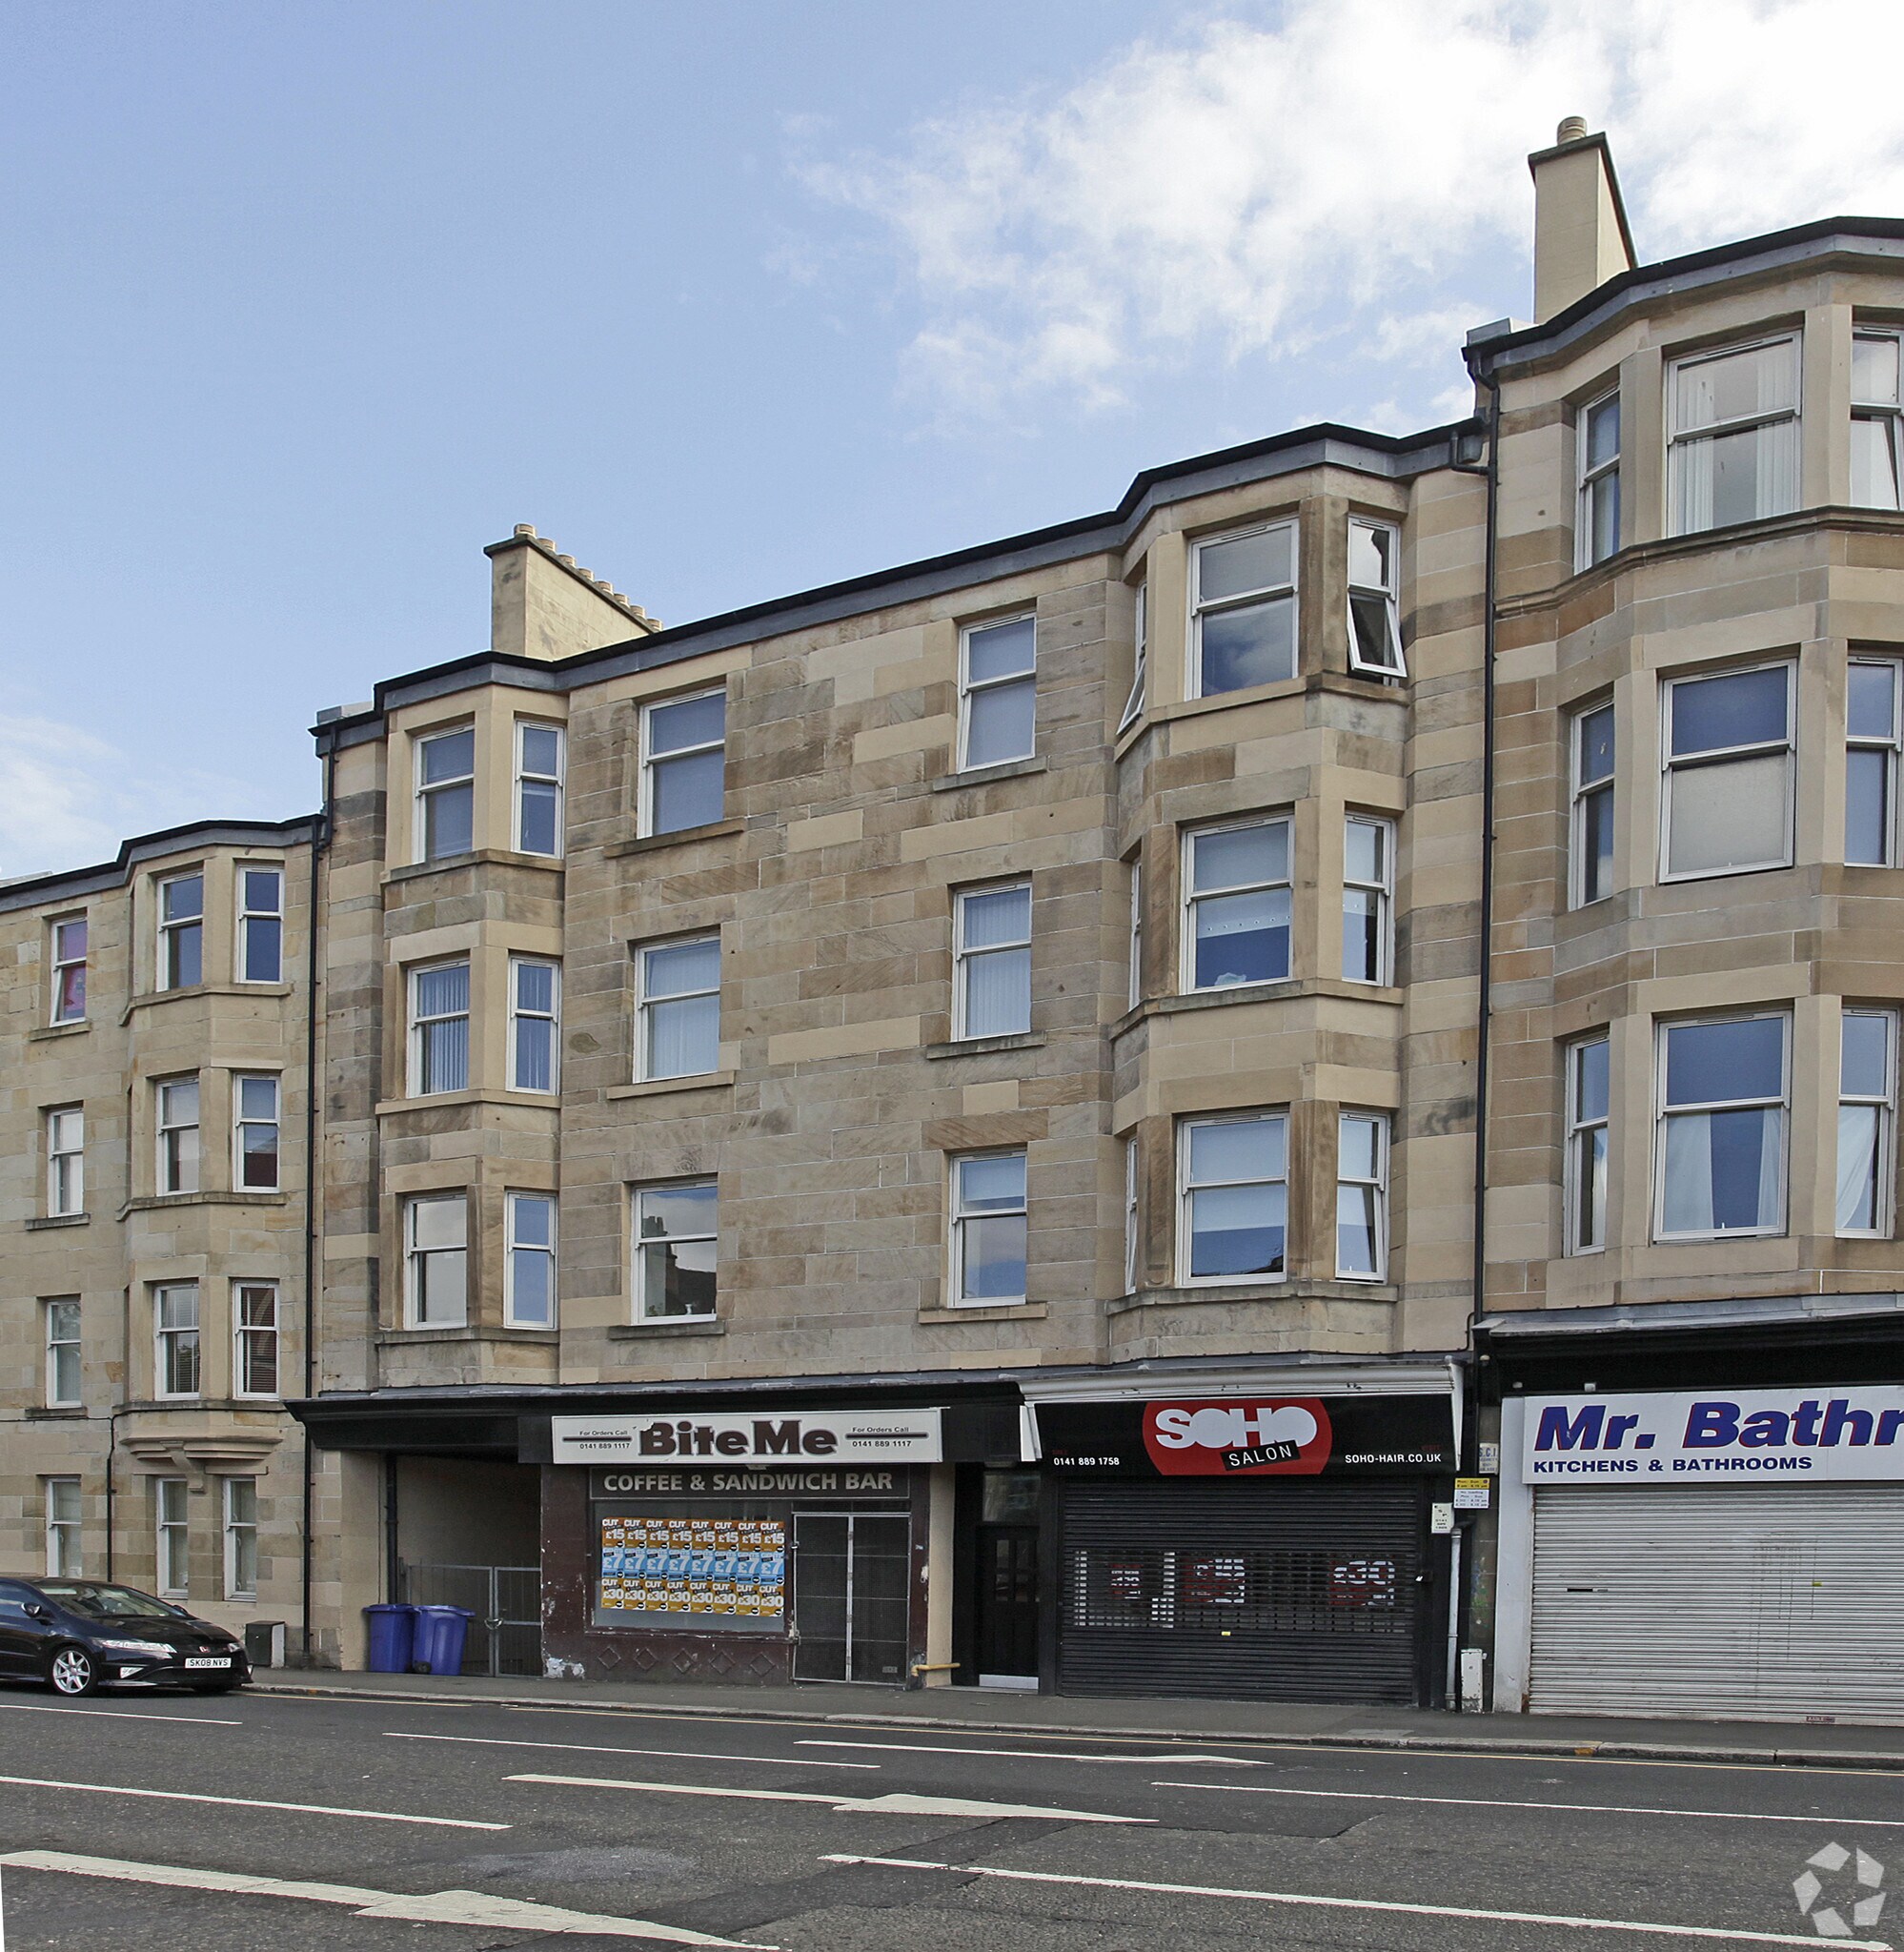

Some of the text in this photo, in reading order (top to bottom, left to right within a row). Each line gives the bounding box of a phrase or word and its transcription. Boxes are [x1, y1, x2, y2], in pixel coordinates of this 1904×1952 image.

[1155, 1406, 1317, 1449] SOHO
[1534, 1399, 1904, 1452] Mr. Bathr
[1054, 1457, 1120, 1466] 0141 889 1758
[1228, 1445, 1292, 1467] SALON
[1346, 1454, 1441, 1463] SOHO-HAIR.CO.UK
[1533, 1456, 1813, 1474] KITCHENS & BATHROOMS
[603, 1474, 892, 1492] COFFEE & SANDWICH BAR
[606, 1529, 624, 1539] £15
[627, 1530, 646, 1539] £15
[650, 1531, 669, 1540] £15
[673, 1531, 692, 1541] £15
[696, 1532, 715, 1542] £15
[719, 1533, 739, 1542] £15
[742, 1533, 761, 1543] £15
[764, 1533, 784, 1544] £15
[603, 1554, 623, 1568] £7
[625, 1554, 645, 1569] £7
[647, 1555, 667, 1570] £7
[669, 1555, 690, 1571] £7
[692, 1556, 713, 1572] £7
[715, 1556, 737, 1573] £7
[738, 1557, 760, 1574] £7
[760, 1558, 783, 1575] £7
